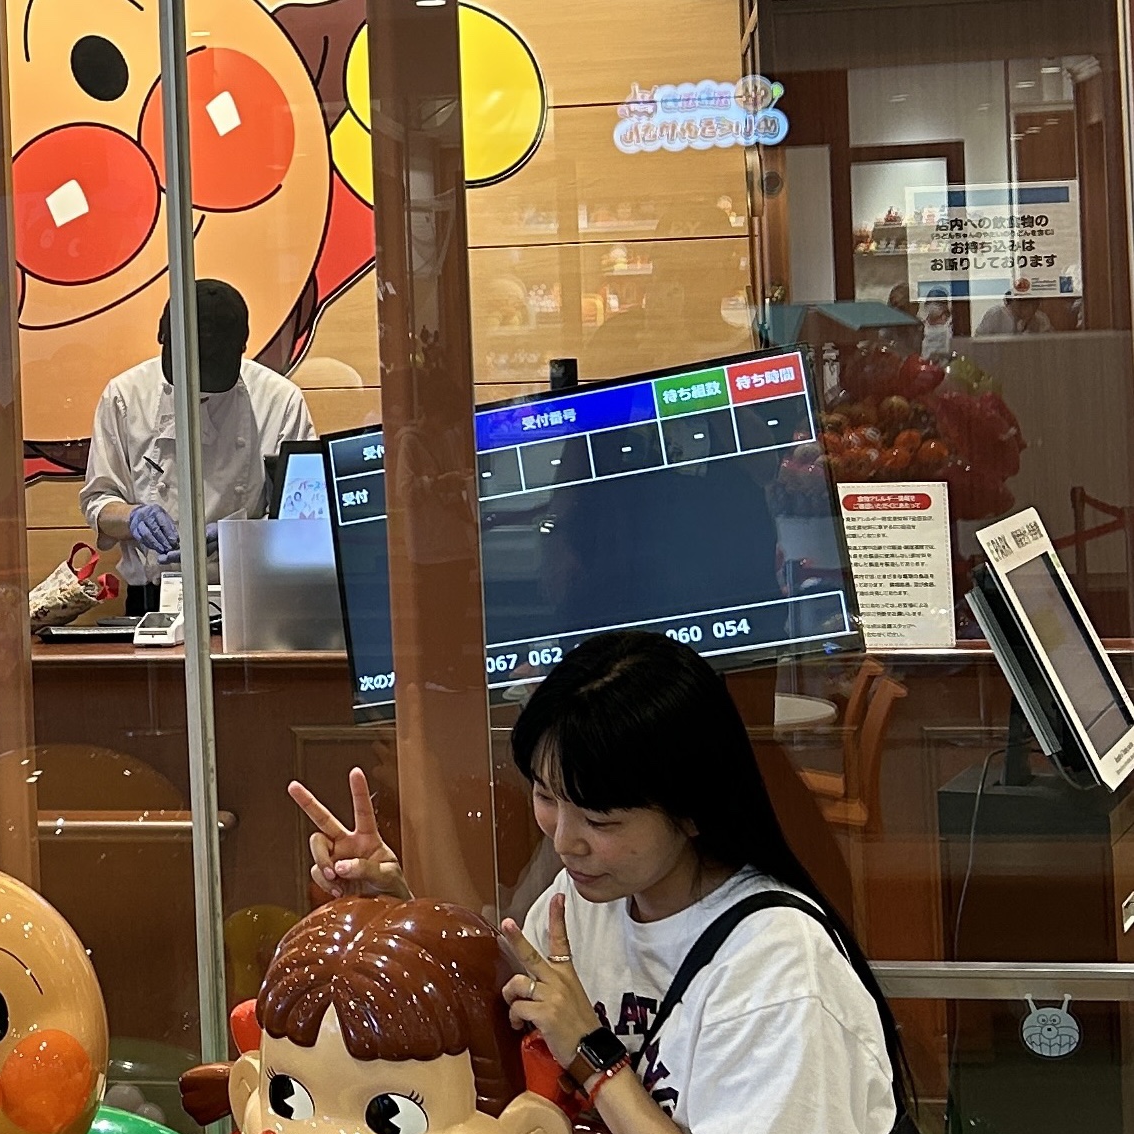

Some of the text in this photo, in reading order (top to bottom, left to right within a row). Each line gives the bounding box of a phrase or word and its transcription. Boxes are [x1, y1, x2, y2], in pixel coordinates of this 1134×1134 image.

[935, 215, 1049, 231] 店内への飲食物の
[951, 239, 1035, 254] お持ち込みは
[930, 254, 1057, 271] お断りしております
[735, 367, 795, 391] 待ち時間
[662, 381, 722, 405] 待ち組数
[521, 408, 577, 431] 受付番号
[342, 488, 369, 506] 受付
[486, 653, 518, 673] 067
[528, 646, 563, 667] 062
[712, 618, 751, 639] 054
